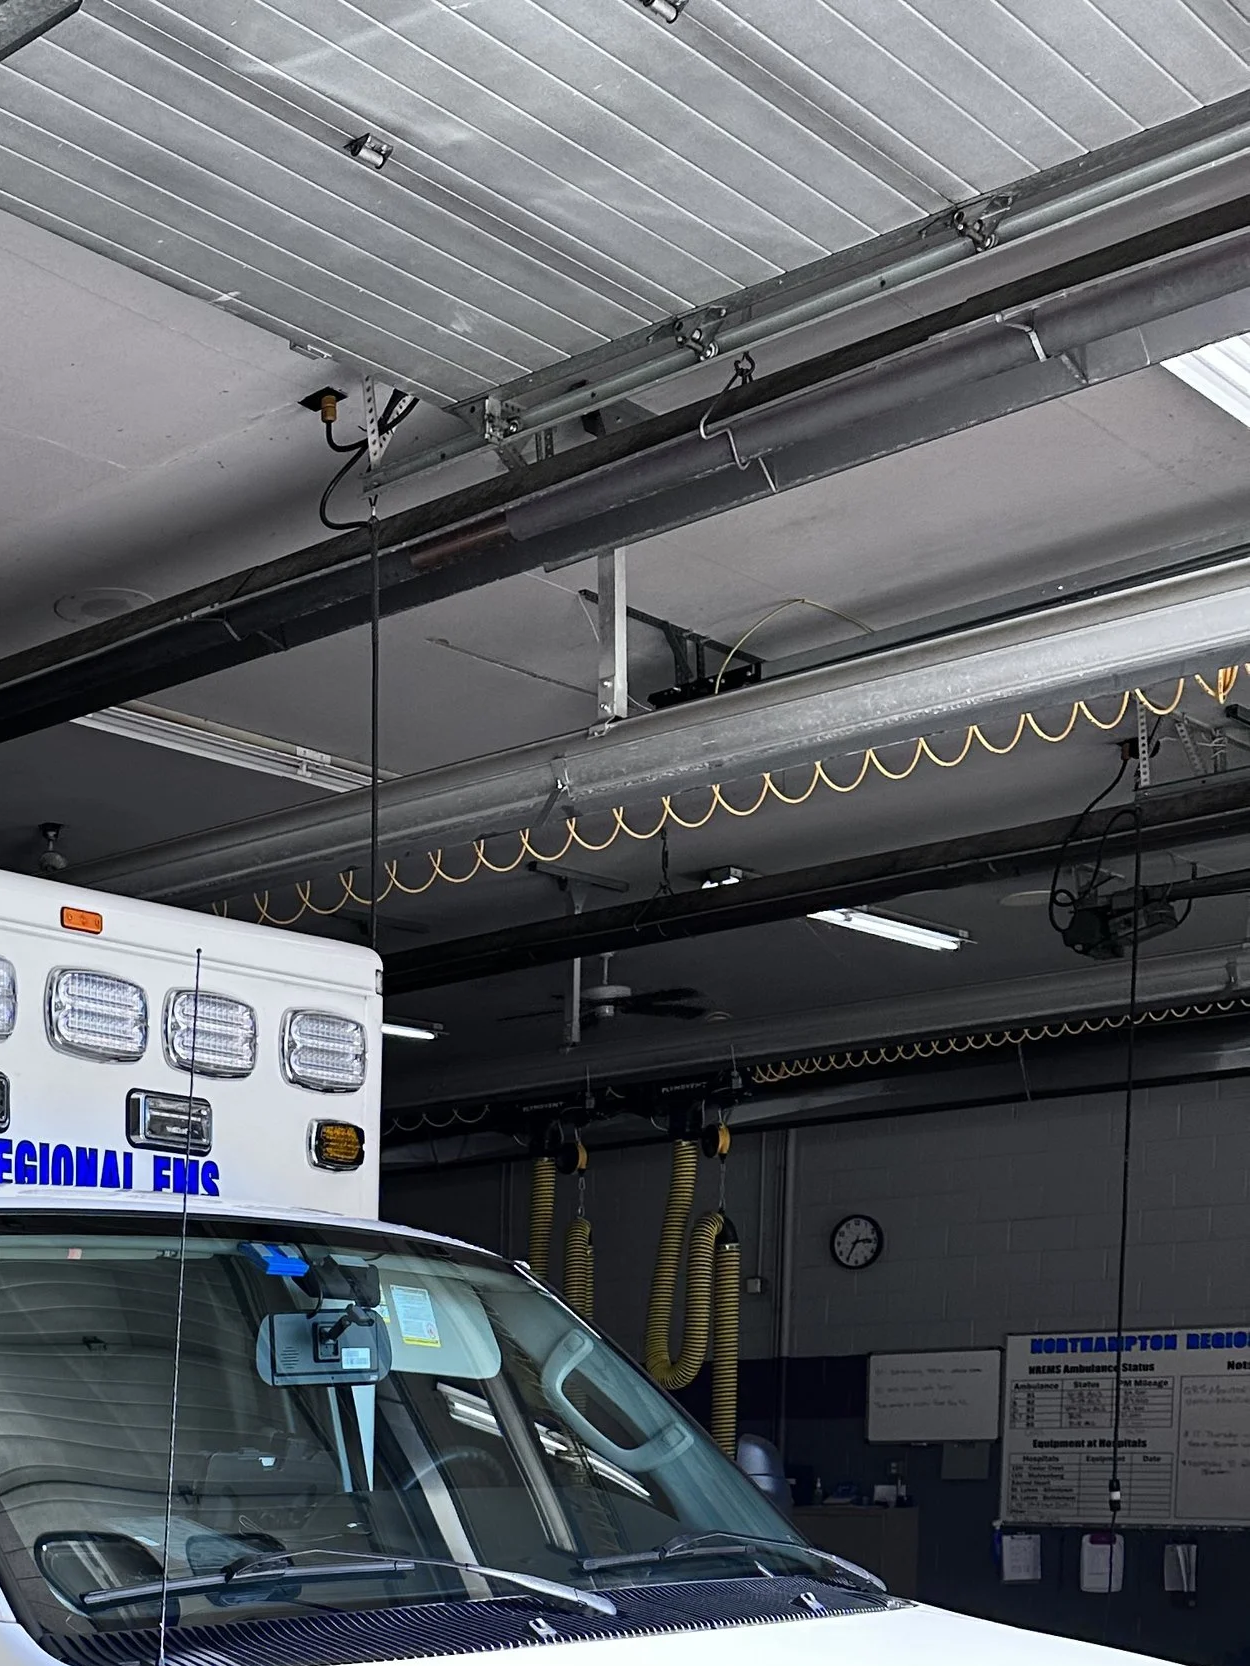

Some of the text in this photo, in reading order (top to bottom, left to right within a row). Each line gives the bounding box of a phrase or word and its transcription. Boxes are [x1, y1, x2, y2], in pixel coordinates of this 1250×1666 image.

[153, 1155, 220, 1197] EMS
[1030, 1331, 1250, 1355] NORTHAMPTON REGIO
[1122, 1362, 1155, 1373] Status
[1014, 1382, 1059, 1390] Ambulance
[1073, 1381, 1100, 1389] Status
[1033, 1439, 1148, 1449] Equipment at Hopitals
[1086, 1455, 1126, 1463] Equipmnt
